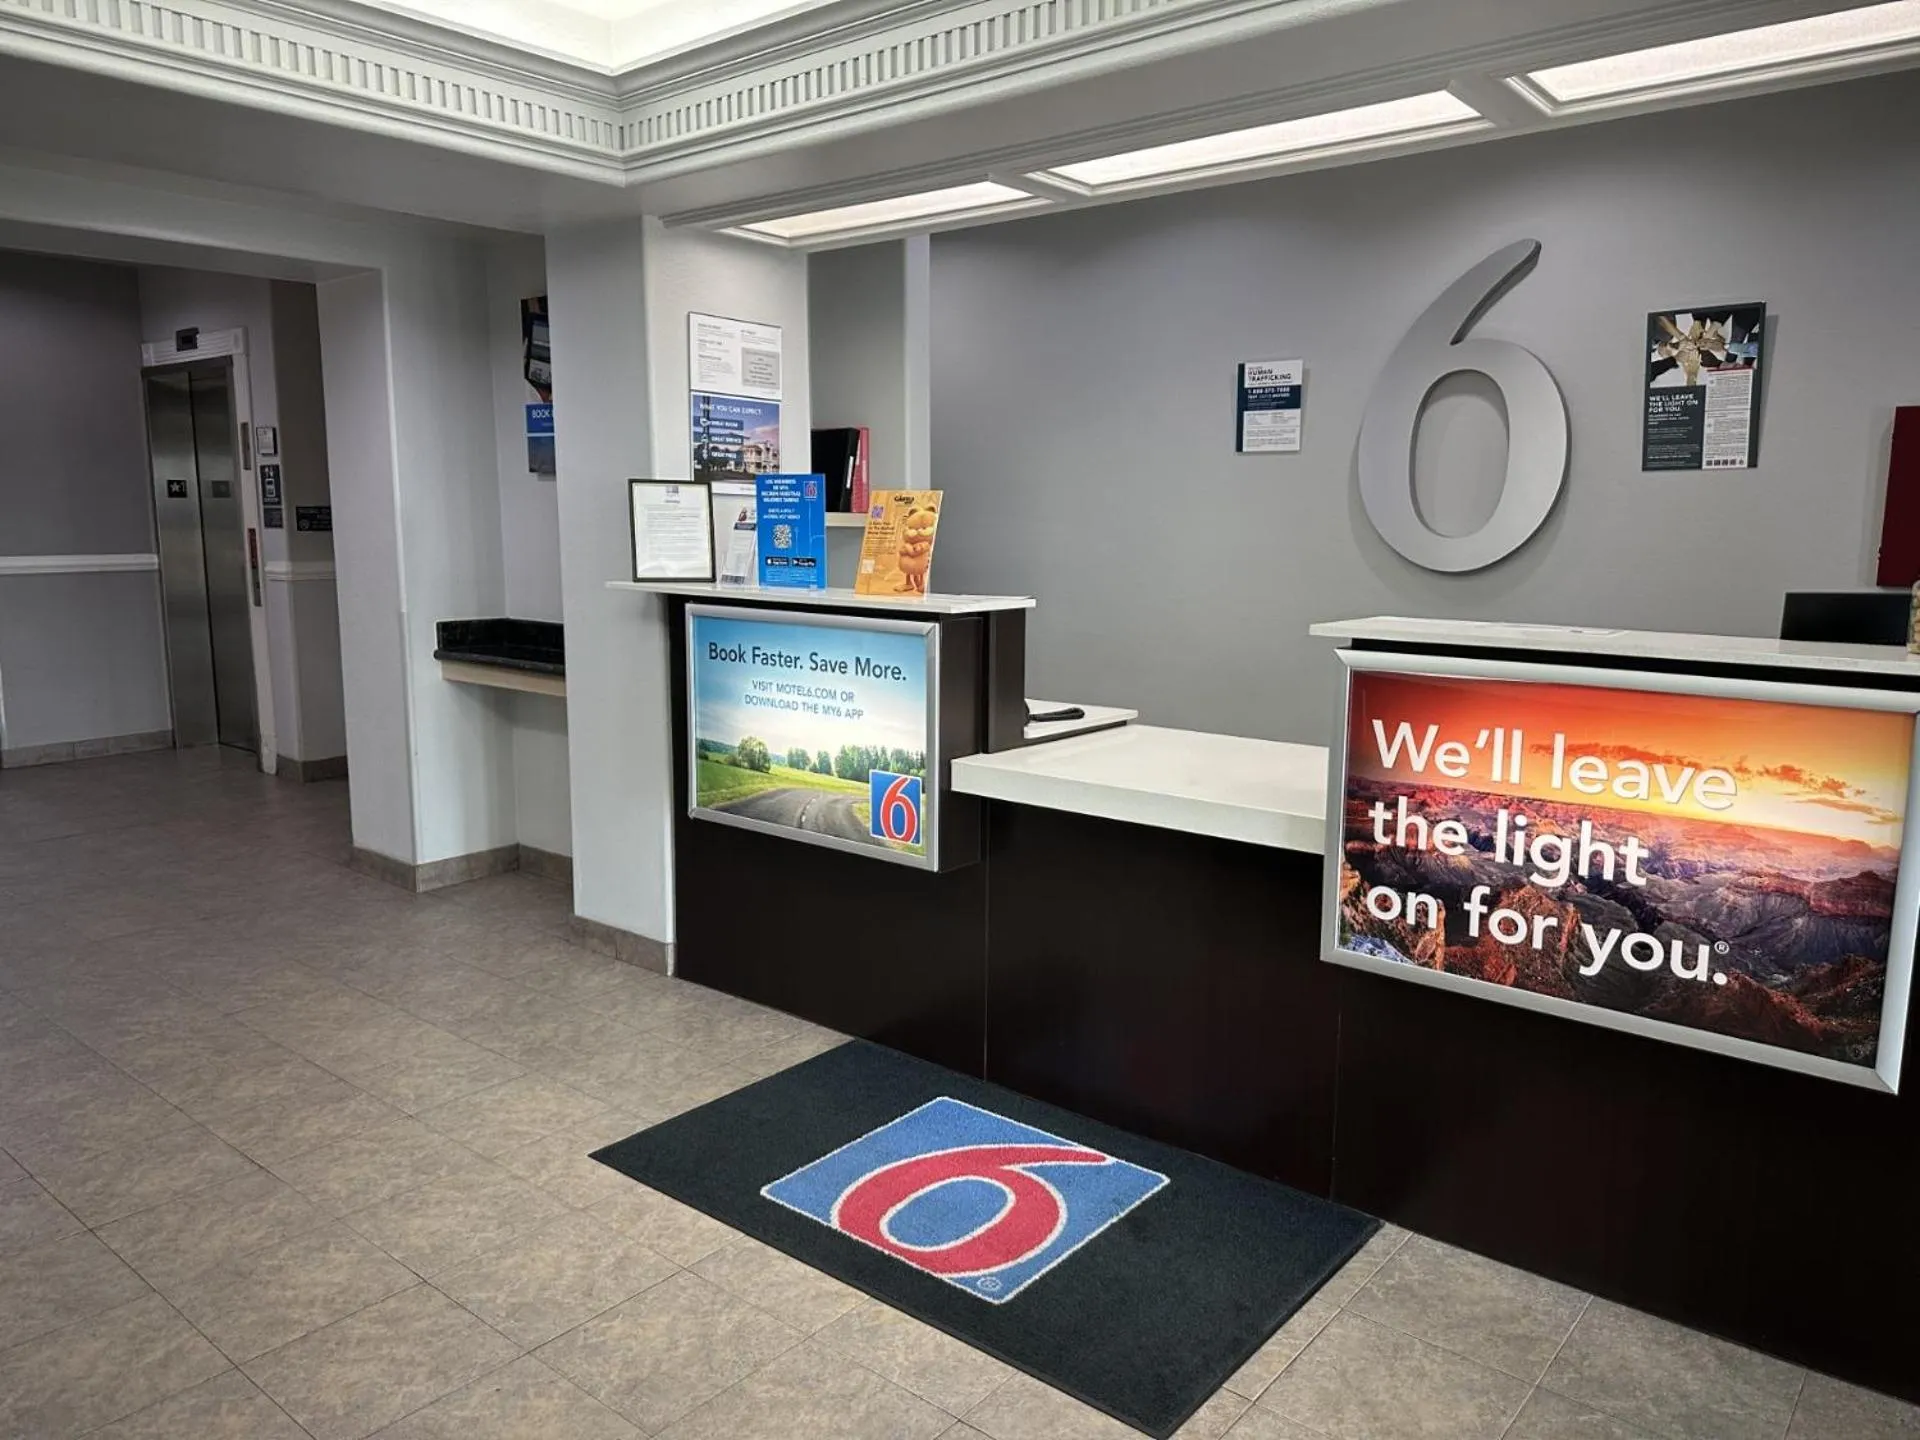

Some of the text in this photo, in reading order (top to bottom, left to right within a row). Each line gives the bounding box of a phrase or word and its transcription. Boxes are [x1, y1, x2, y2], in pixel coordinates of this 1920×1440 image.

[1248, 373, 1292, 382] TRAFFICKING
[1357, 238, 1572, 575] 6
[1671, 393, 1694, 401] LEAVE
[708, 641, 907, 681] Book Faster. Save More.
[752, 680, 854, 703] VISIT MOTEL6.COM OR
[744, 694, 864, 720] DOWNLOAD THE MY6 APP
[1371, 718, 1738, 811] We'll leave
[880, 775, 918, 844] 6
[1368, 796, 1649, 888] the light
[1366, 884, 1438, 929] on
[1462, 885, 1559, 950] for
[830, 1143, 1114, 1278] 6
